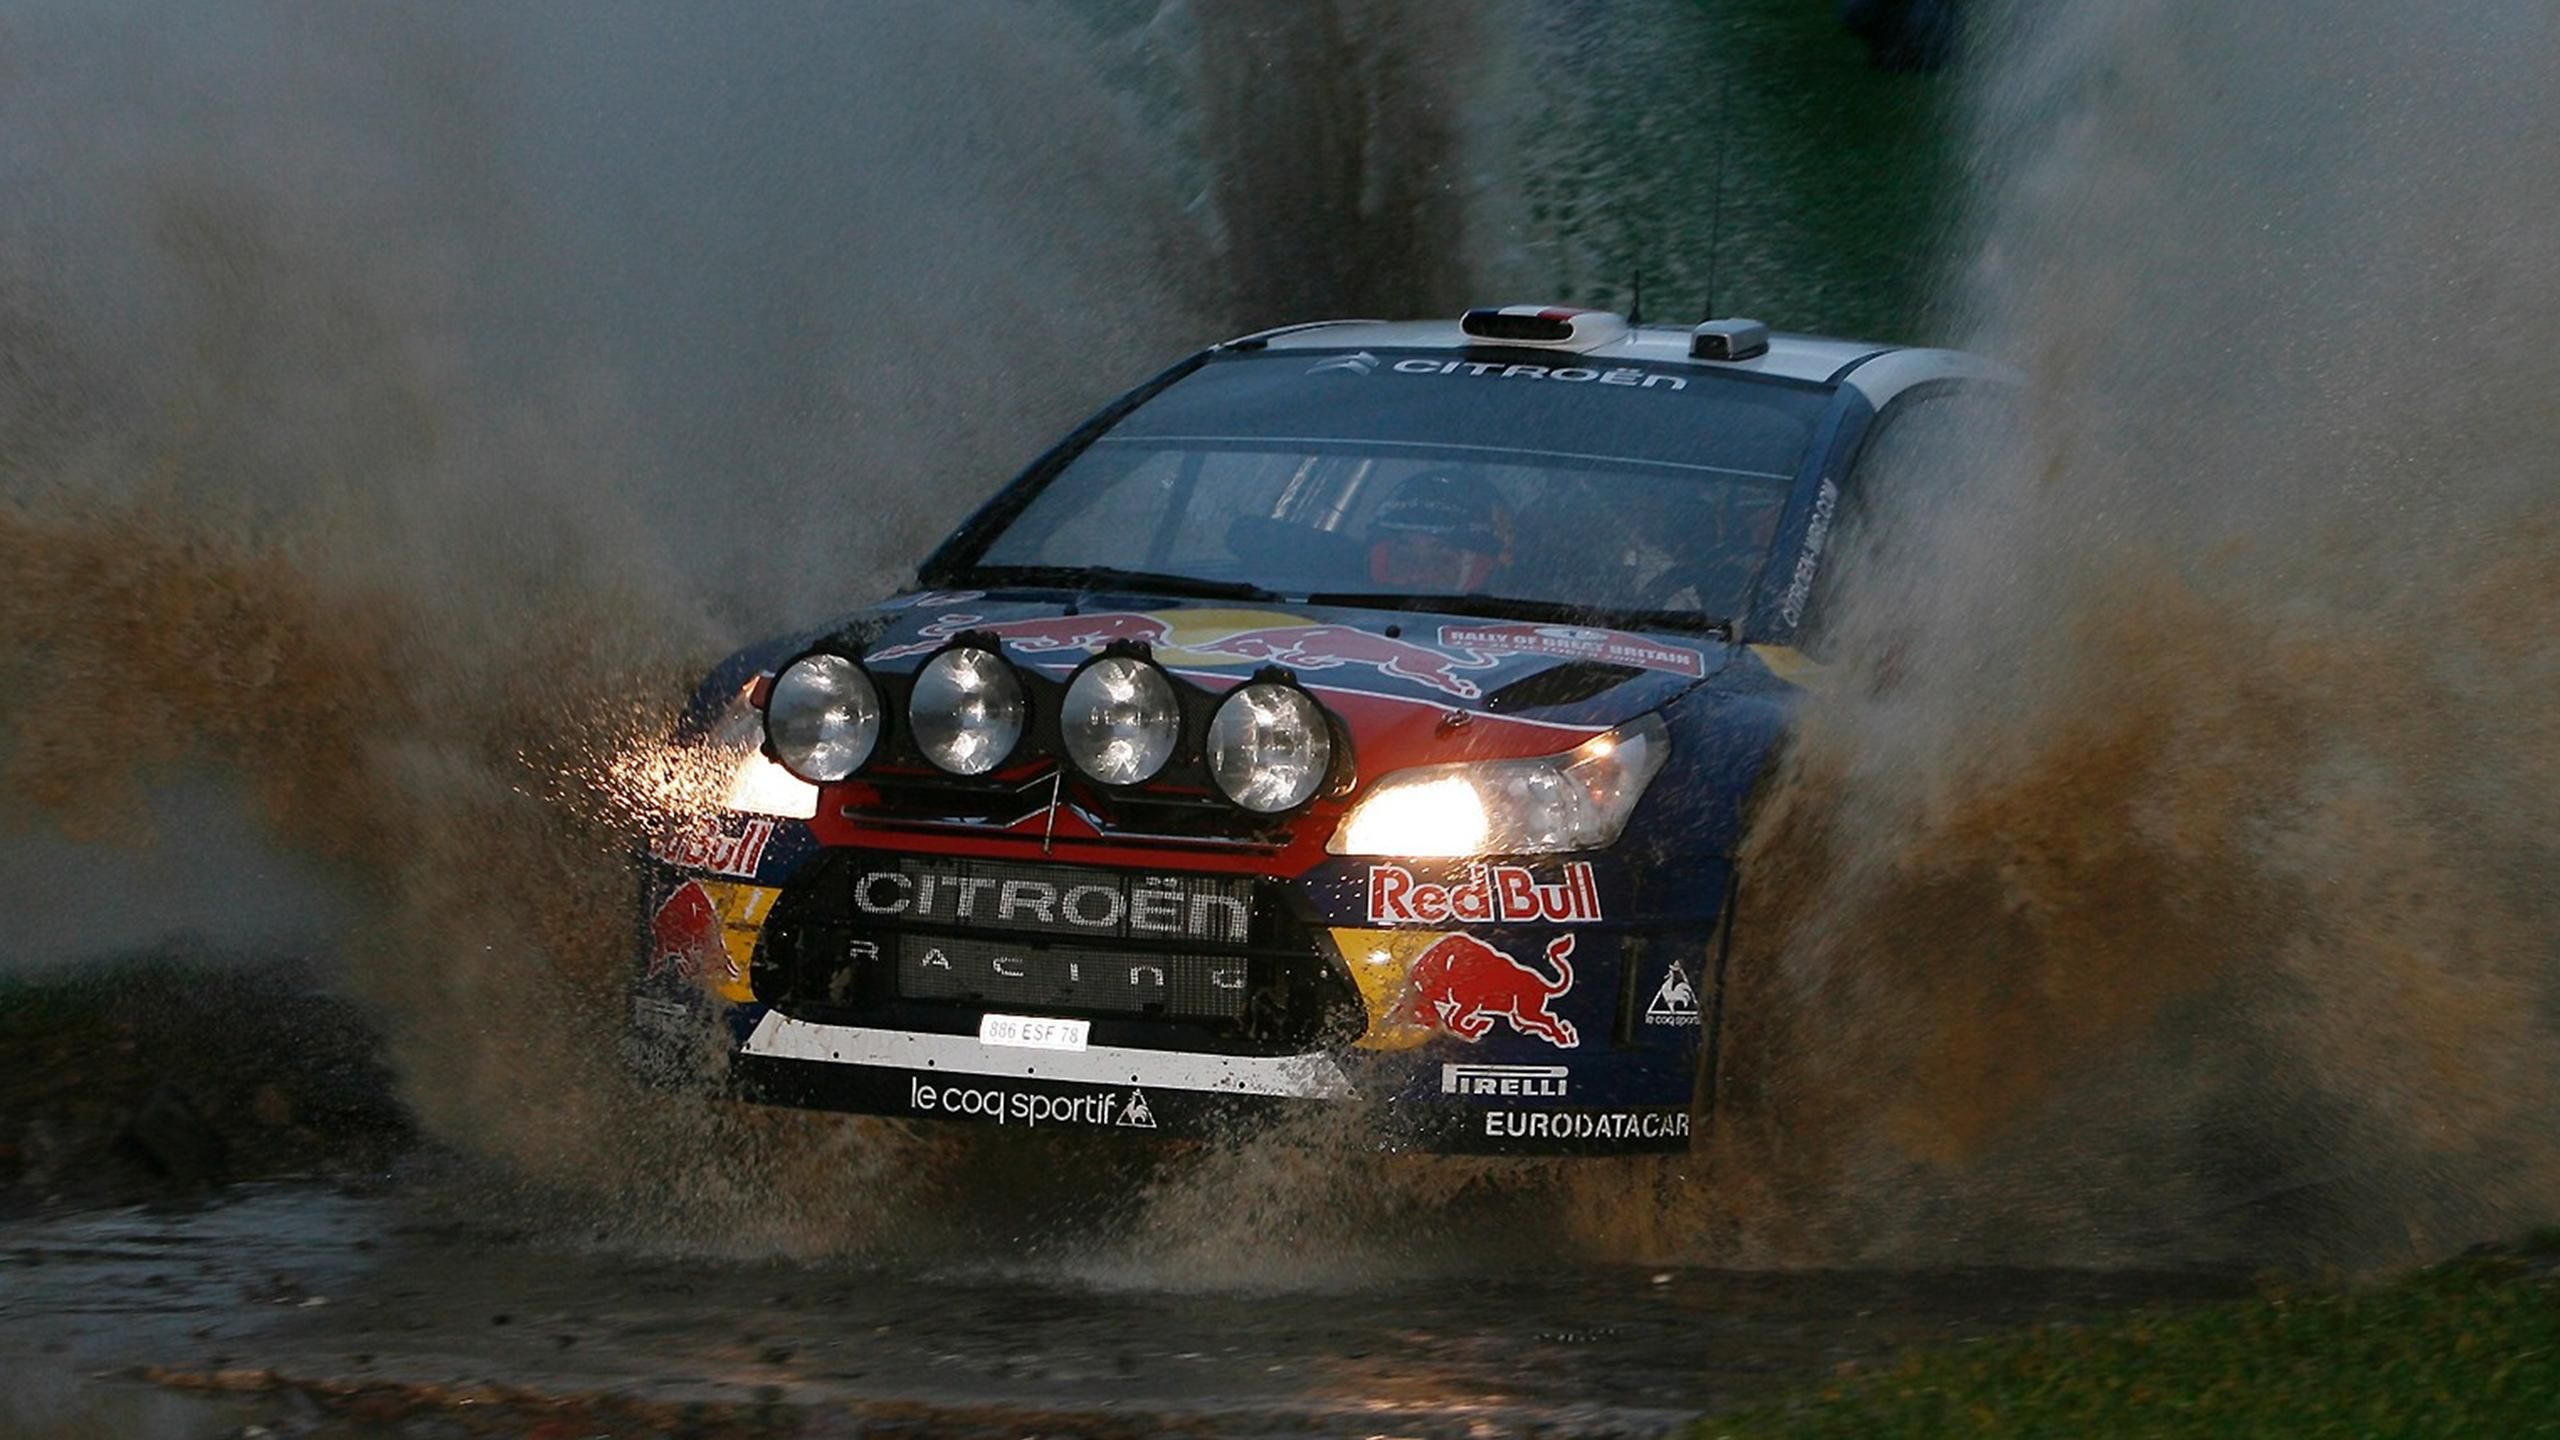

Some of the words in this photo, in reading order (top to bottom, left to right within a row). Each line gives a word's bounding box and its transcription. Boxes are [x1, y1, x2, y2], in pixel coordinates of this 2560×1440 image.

[1450, 631, 1508, 644] RALLY
[1513, 635, 1537, 647] OF
[1542, 637, 1606, 655] GREAT
[1609, 645, 1691, 666] BRITAIN
[1367, 865, 1495, 923] Red
[1493, 861, 1602, 922] Bull
[988, 1020, 1017, 1039] 886
[1021, 1023, 1055, 1041] ESF
[1061, 1026, 1079, 1044] 78
[1441, 1063, 1569, 1095] PIRELLI
[911, 1076, 938, 1110] le
[942, 1087, 1005, 1124] coq
[1010, 1091, 1116, 1127] sportif
[1486, 1111, 1690, 1138] EURODATACAR
